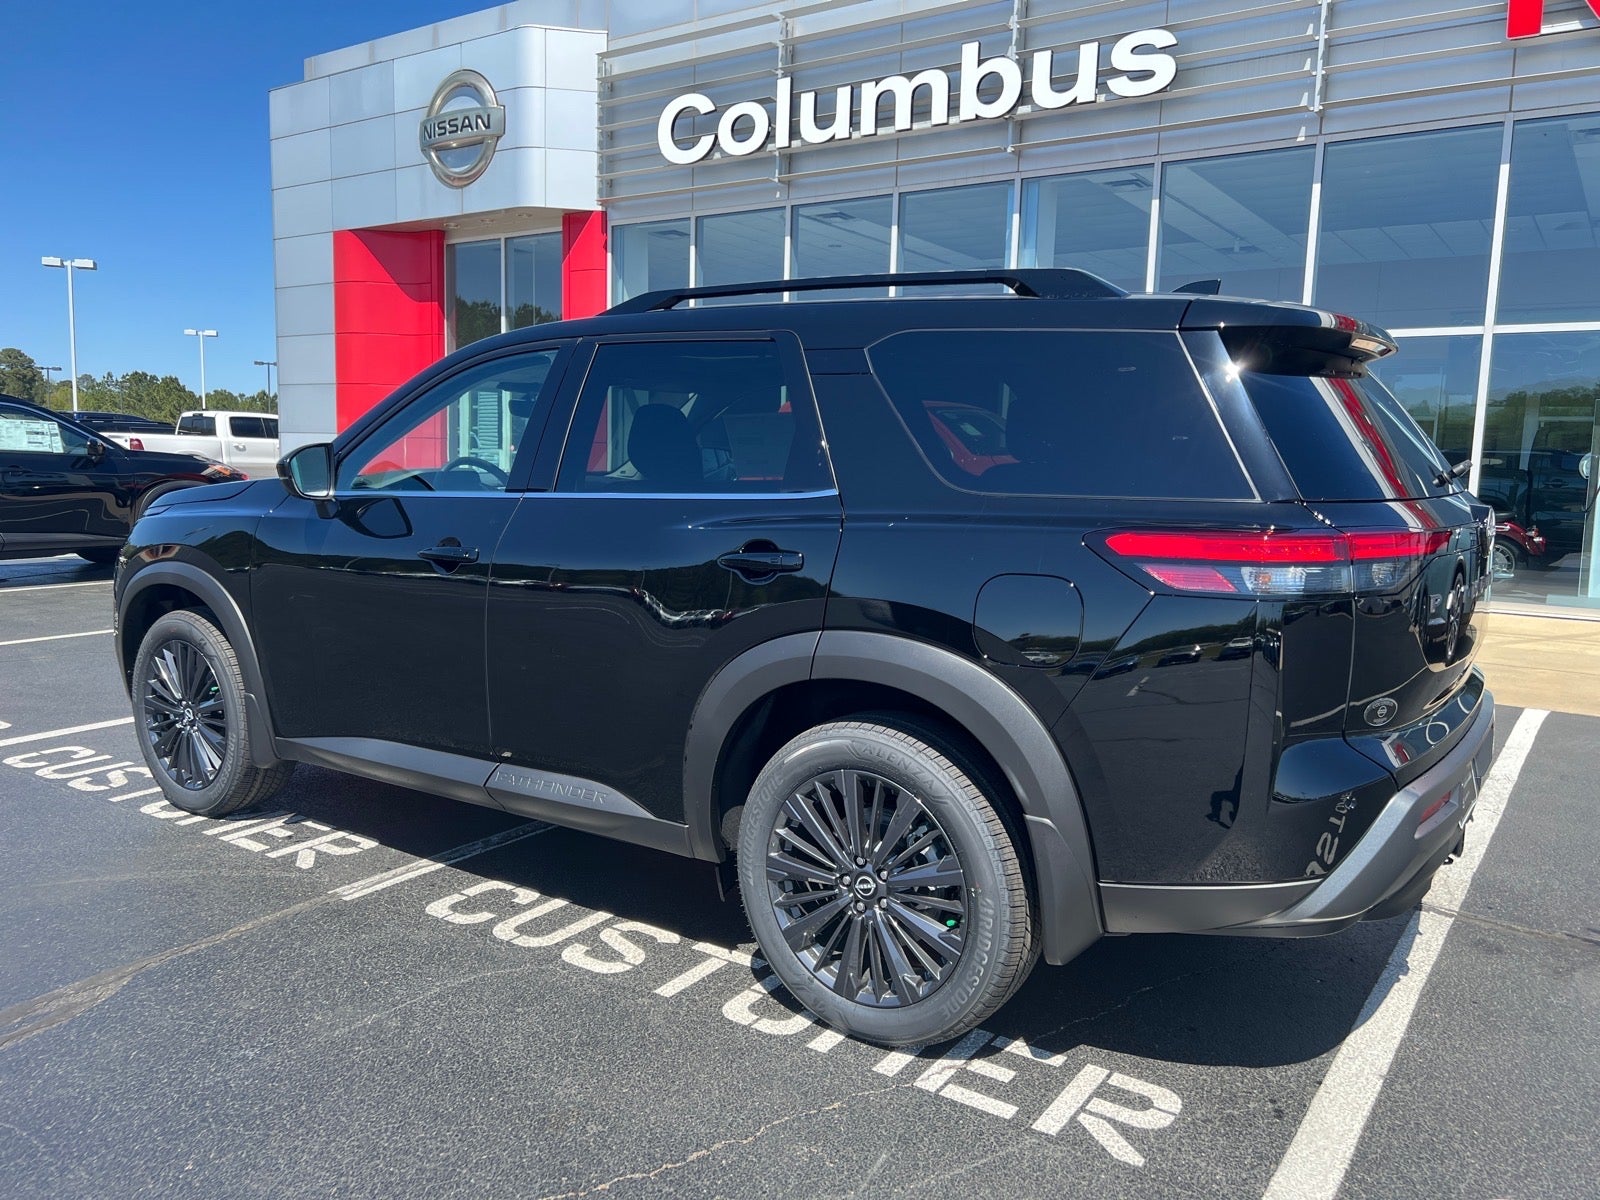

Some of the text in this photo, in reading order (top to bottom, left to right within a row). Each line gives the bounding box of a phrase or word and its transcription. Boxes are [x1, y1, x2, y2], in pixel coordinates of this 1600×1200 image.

[423, 113, 491, 141] NISSAN
[657, 28, 1178, 165] Columbus
[2, 746, 379, 869] CUSER
[494, 771, 609, 804] PATHFINDER
[862, 744, 937, 789] ALENZA
[940, 897, 995, 1021] BRIDGESTONE
[425, 880, 1183, 1168] CUSTOER
